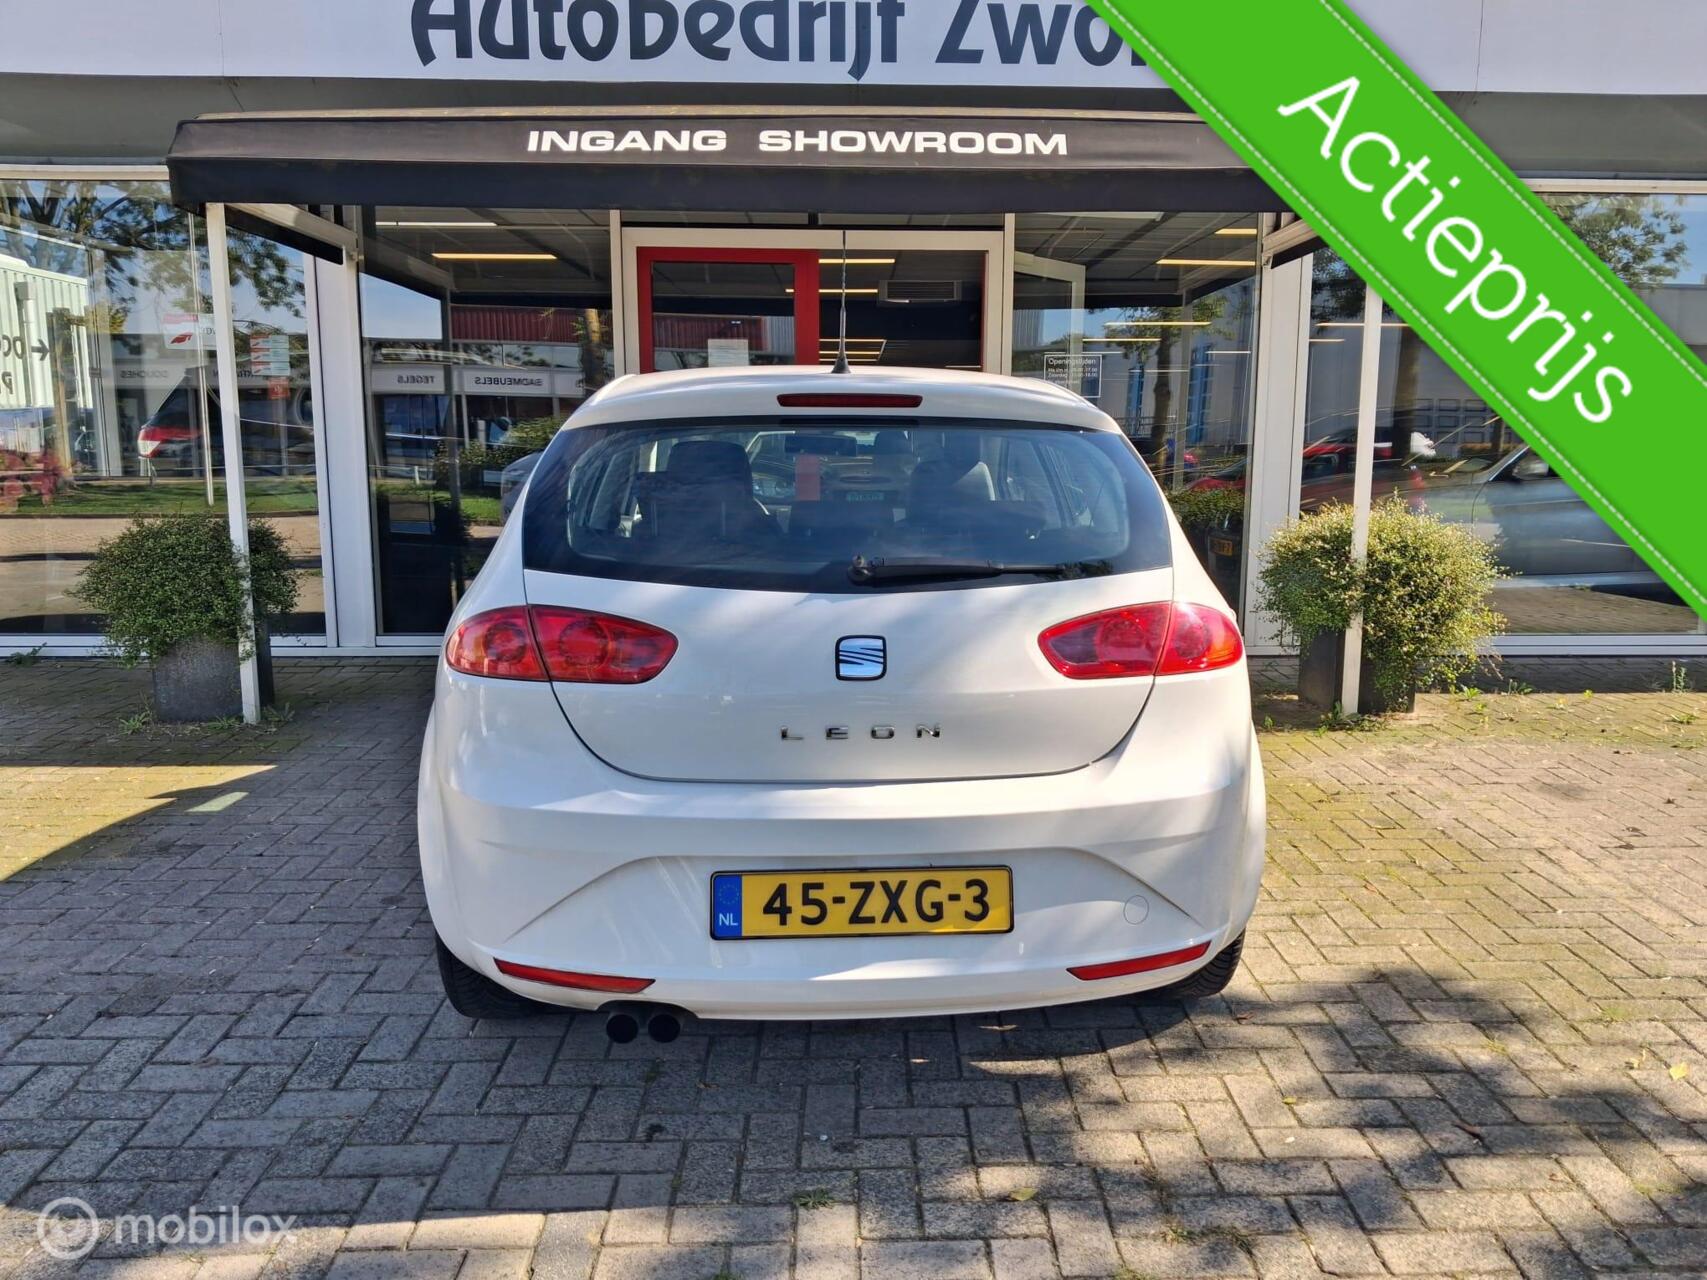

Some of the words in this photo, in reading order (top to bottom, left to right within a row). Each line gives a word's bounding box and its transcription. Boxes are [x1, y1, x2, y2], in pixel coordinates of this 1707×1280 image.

[935, 0, 1147, 66] Zwo
[527, 130, 727, 152] INGANG
[758, 130, 1068, 155] SHOWROOM
[780, 724, 941, 741] LEON
[762, 879, 990, 927] 45-ZXG-3
[719, 912, 738, 927] NL
